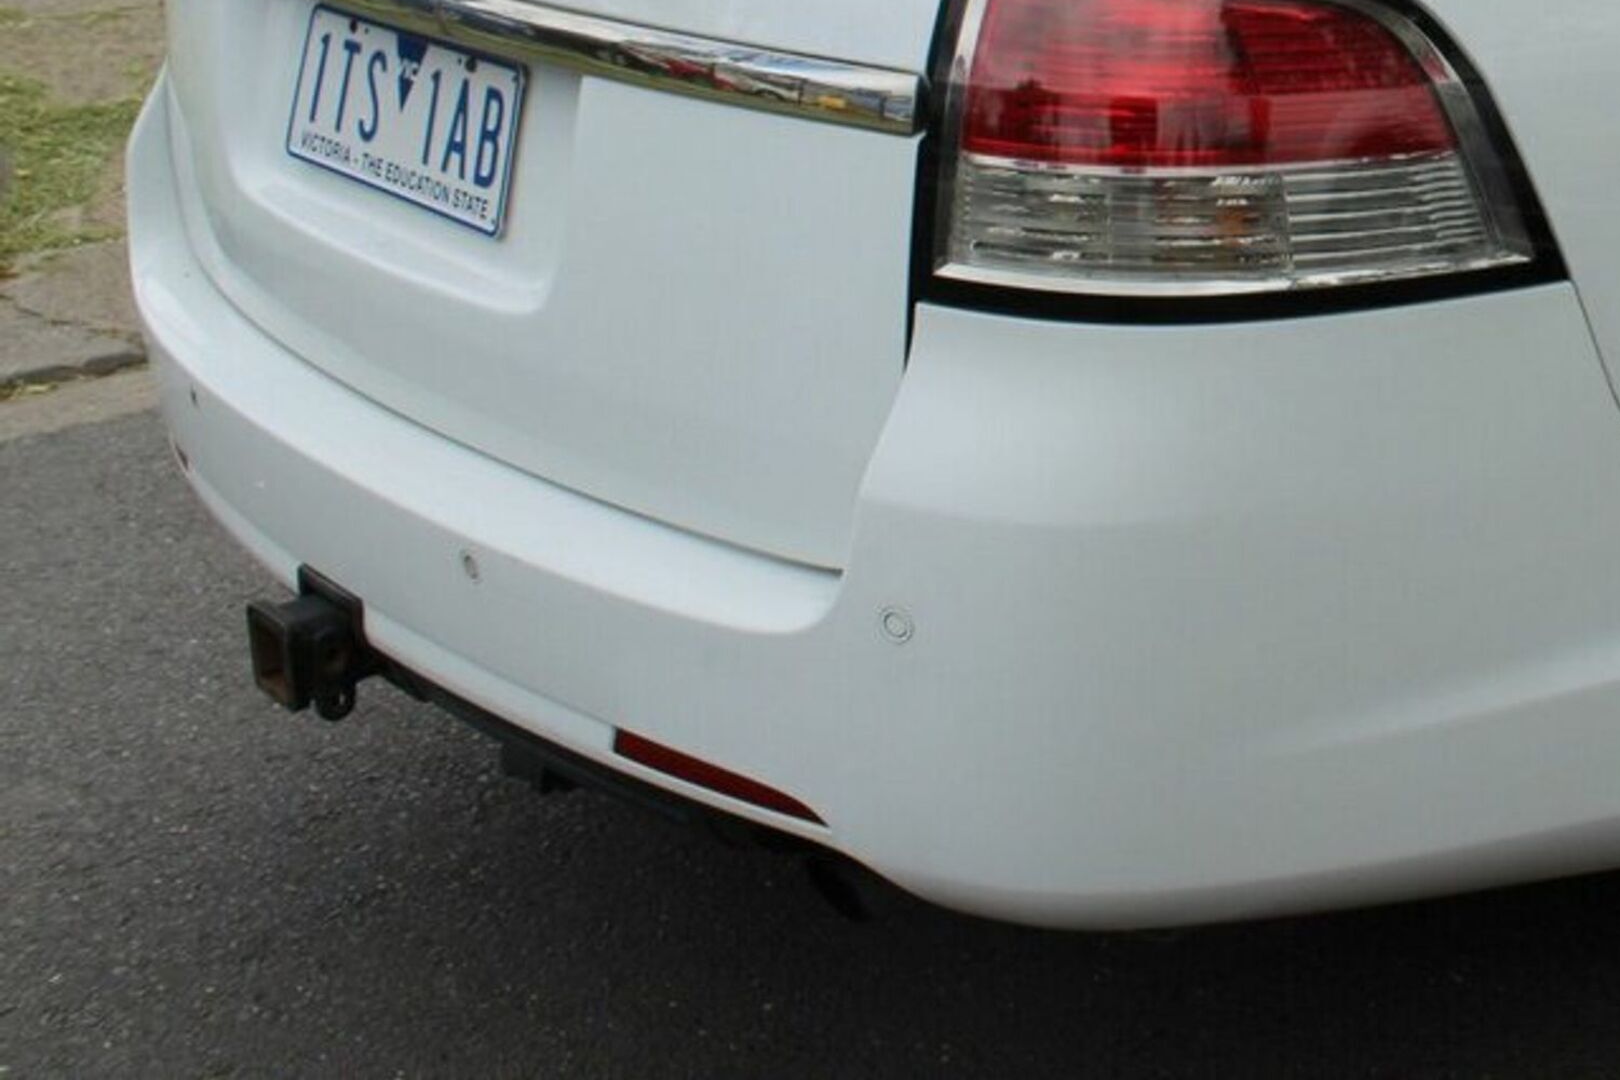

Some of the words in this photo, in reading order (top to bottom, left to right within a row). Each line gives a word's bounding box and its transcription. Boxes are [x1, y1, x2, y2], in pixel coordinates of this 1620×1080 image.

[309, 33, 389, 142] 1TS
[421, 69, 505, 190] 1AB
[301, 130, 352, 164] VICTORIA
[361, 151, 385, 179] THE
[385, 161, 450, 204] EDUCATION
[453, 187, 489, 221] STATE
